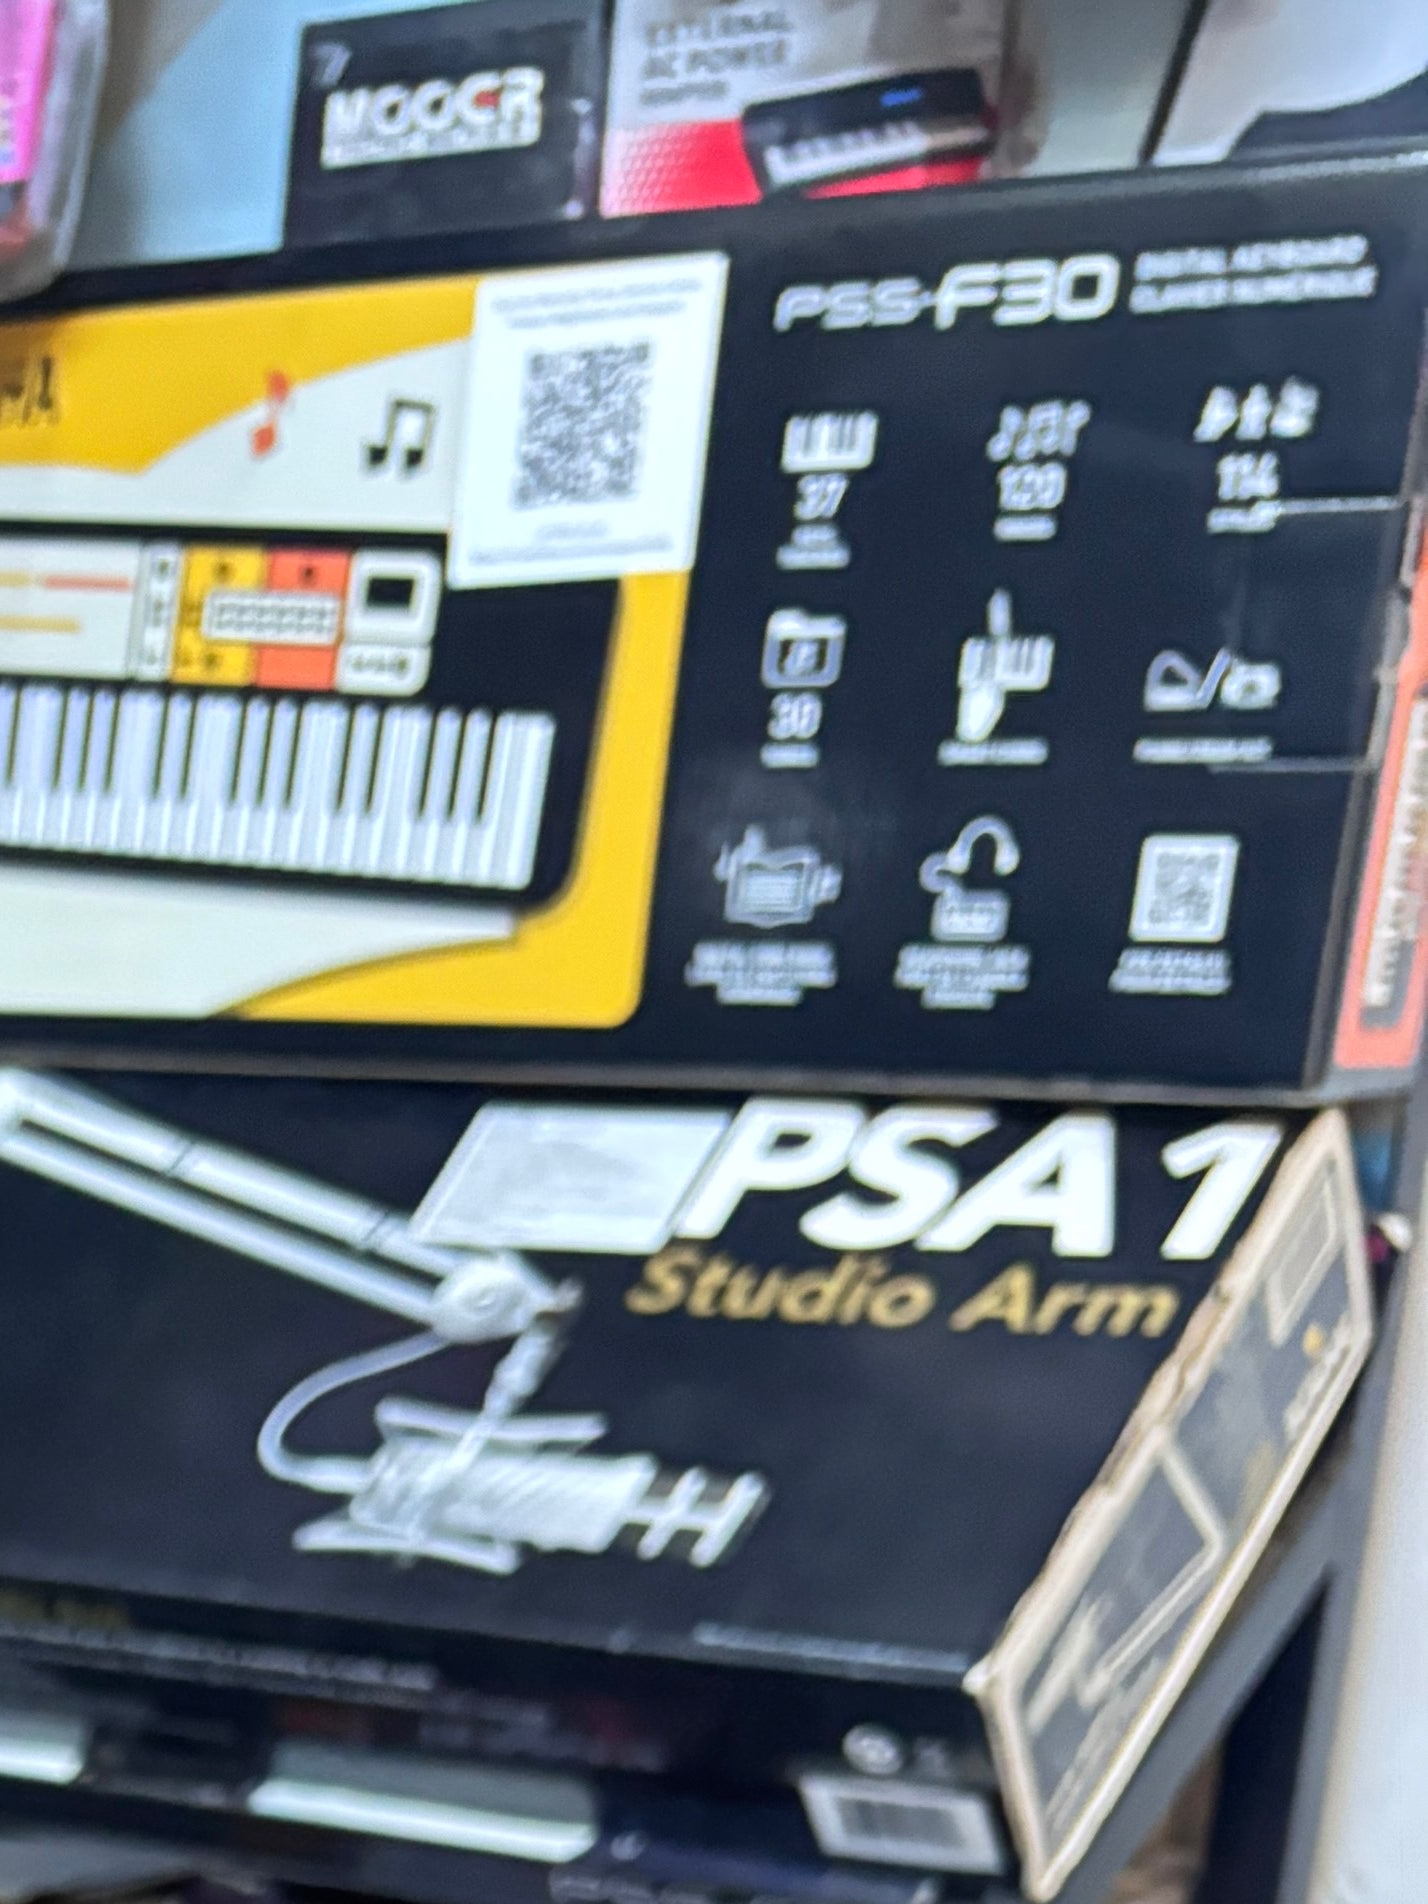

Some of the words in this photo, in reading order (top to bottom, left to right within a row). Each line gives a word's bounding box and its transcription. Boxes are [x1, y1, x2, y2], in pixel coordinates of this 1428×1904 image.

[773, 253, 1121, 332] PSS-F30
[624, 1244, 937, 1329] Studio
[950, 1261, 1183, 1339] Arm
